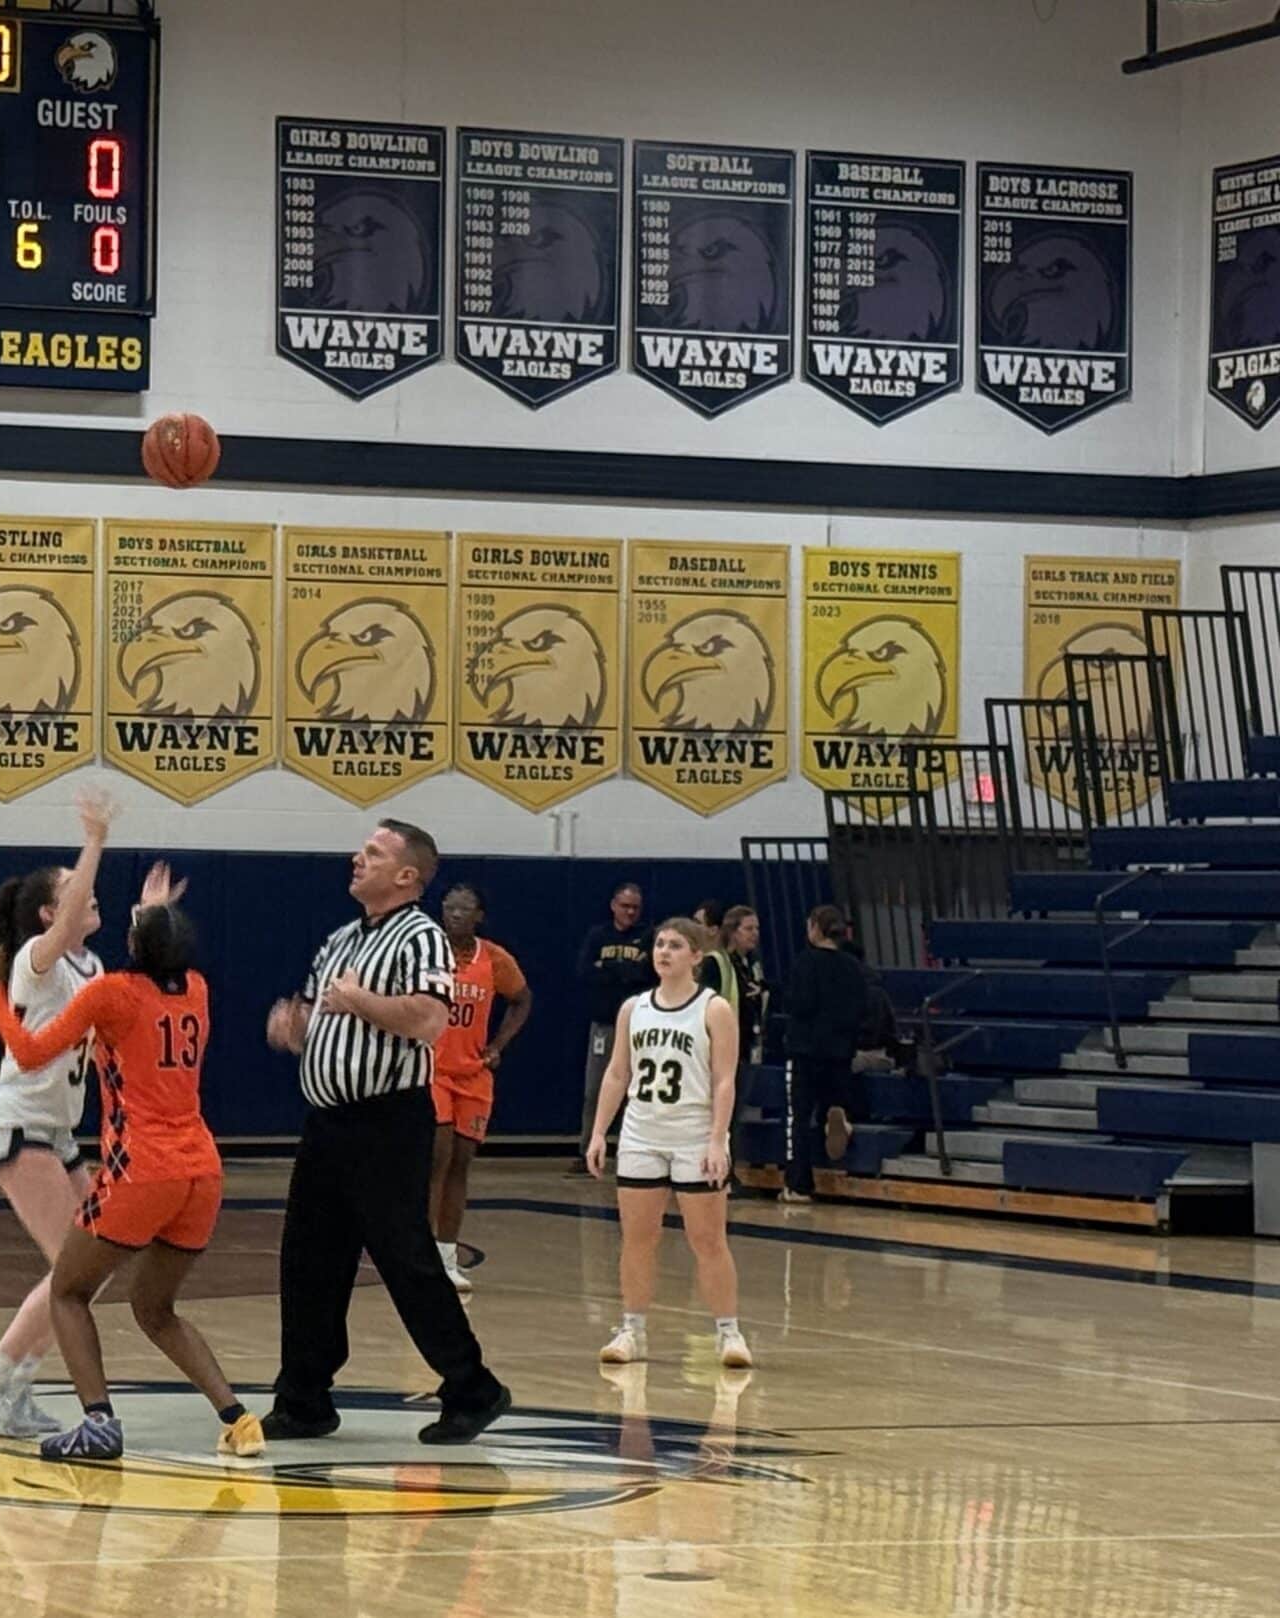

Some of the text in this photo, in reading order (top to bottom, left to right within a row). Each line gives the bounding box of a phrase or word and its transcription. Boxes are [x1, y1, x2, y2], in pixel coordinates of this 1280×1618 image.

[37, 99, 118, 130] GUEST
[290, 129, 428, 153] GIRLS BOWLING
[286, 151, 436, 172] LEAGUE CHAMPIONS
[470, 139, 599, 165] BOYS BOWLING
[88, 139, 120, 198] 0
[467, 162, 613, 183] LEAGUE CHAMPIONS
[666, 153, 753, 175] SOFTBALL
[642, 174, 786, 195] LEAGUE CHAMPIONS
[815, 184, 956, 205] LEAGUE CHAMPIONS
[989, 175, 1118, 200] BOYS LACROSSE
[8, 200, 51, 220] T.O.L.
[73, 203, 127, 224] FOULS
[984, 195, 1123, 215] LEAGUE CHAMPIONS
[16, 222, 42, 269] 6
[93, 226, 120, 273] 0
[72, 282, 127, 303] SCORE
[285, 316, 428, 355] WAYNE
[464, 325, 604, 365] WAYNE
[0, 330, 142, 371] EAGLES
[324, 351, 395, 370] EAGLES
[641, 336, 778, 375] WAYNE
[502, 359, 571, 380] EAGLES
[813, 344, 947, 383] WAYNE
[984, 353, 1115, 391] WAYNE
[678, 369, 747, 389] EAGLES
[849, 377, 916, 397] EAGLES
[1019, 387, 1085, 405] EAGLES
[118, 537, 247, 554] BOYS BASKETBALL
[296, 544, 427, 562] GIRLS BASKETBALL
[10, 553, 88, 565] CHAMPIONS
[113, 556, 267, 571] SECTIONAL CHAMPIONS
[472, 548, 610, 568] GIRLS BOWLING
[669, 556, 746, 573] BASEBALL
[292, 563, 443, 578] SECTIONAL CHAMPIONS
[467, 569, 613, 584] SECTIONAL CHAMPIONS
[829, 561, 938, 580] BOYS TENNIS
[1031, 569, 1175, 587] GIRLS TRACK AND FIELD
[638, 575, 782, 590] SECTIONAL CHAMPIONS
[813, 582, 952, 597] SECTIONAL CHAMPIONS
[1034, 589, 1172, 605] SECTIONAL CHAMPIONS
[113, 606, 142, 617] 2021
[115, 721, 259, 756] WAYNE
[294, 726, 434, 761] WAYNE
[467, 731, 605, 765] WAYNE
[639, 736, 773, 769] WAYNE
[155, 755, 226, 772] EAGLES
[332, 760, 402, 777] EAGLES
[504, 764, 574, 781] EAGLES
[676, 769, 743, 785] EAGLES
[449, 1003, 475, 1028] 30
[157, 1013, 201, 1069] 13
[632, 1028, 694, 1057] WAYNE
[637, 1058, 682, 1104] 23
